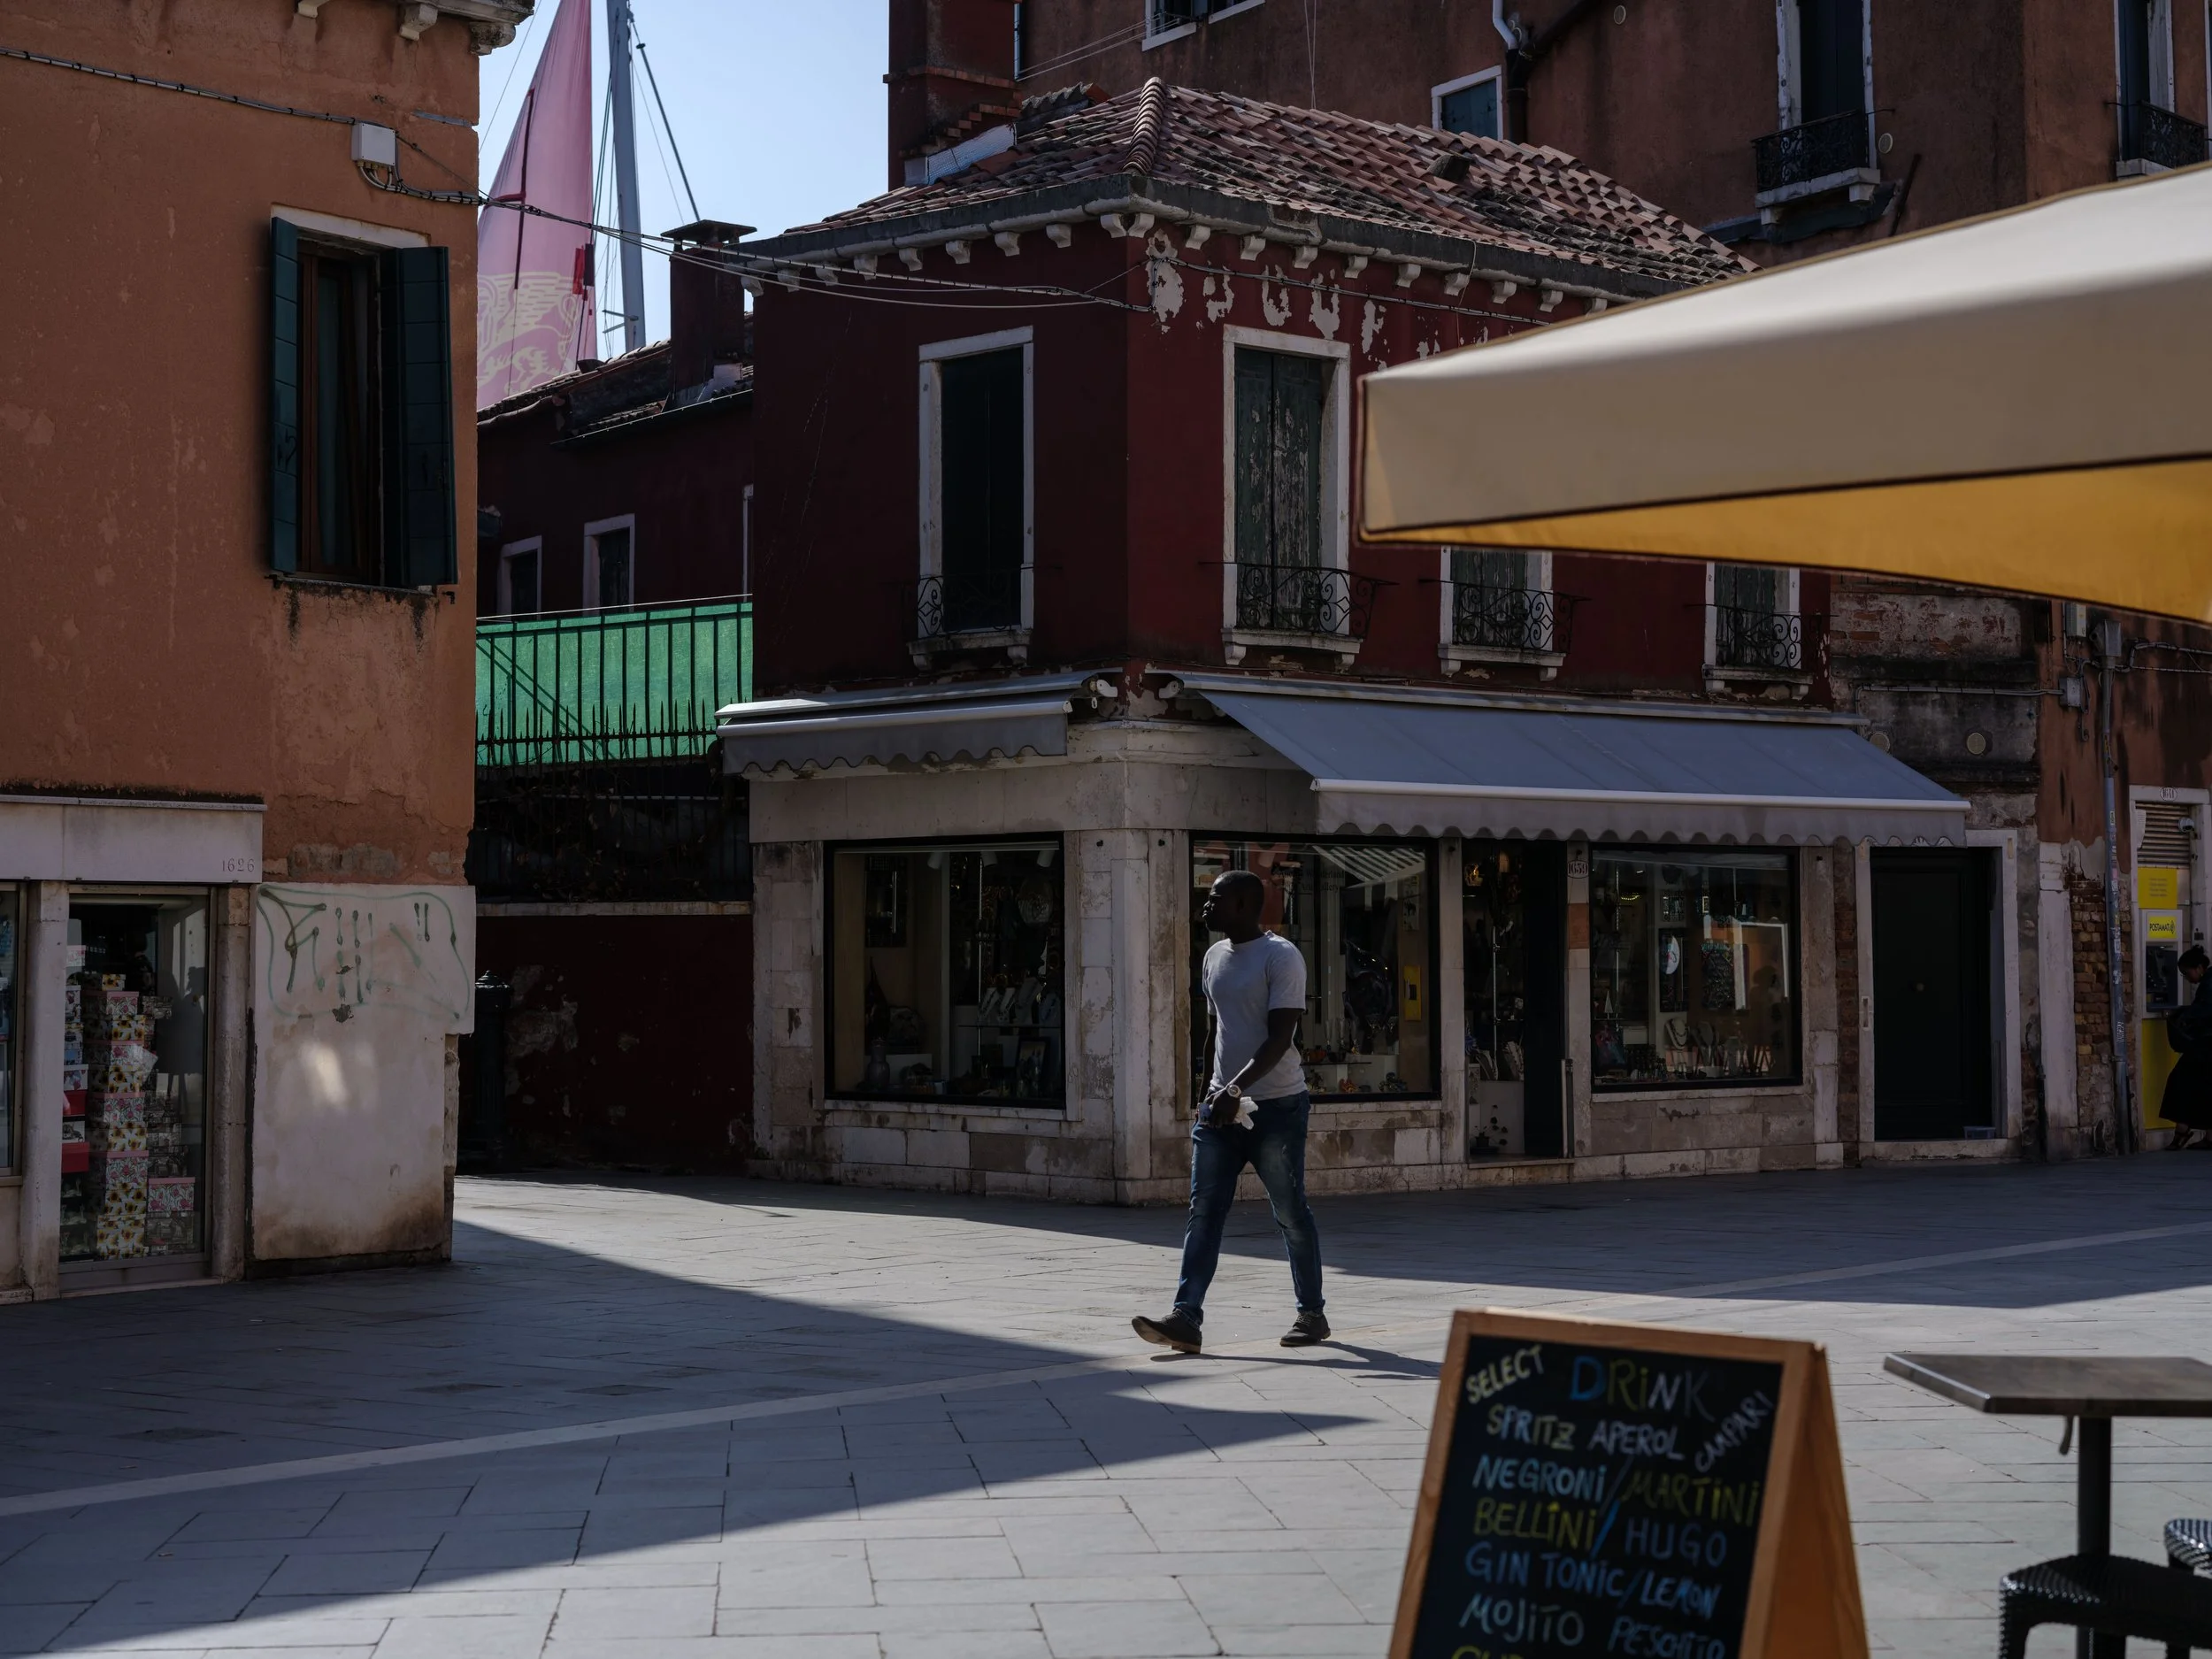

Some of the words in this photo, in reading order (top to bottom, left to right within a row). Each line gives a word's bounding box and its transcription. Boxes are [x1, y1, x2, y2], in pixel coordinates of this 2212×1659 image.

[222, 857, 255, 872] 1626
[1568, 863, 1588, 874] 1659
[2149, 923, 2170, 932] POSTAMAT
[1464, 1344, 1545, 1405] SELECT
[1486, 1402, 1577, 1451] SPRITZ
[1586, 1418, 1686, 1462] APEROL
[1464, 1540, 1532, 1588] GIN
[1624, 1517, 1727, 1569] HUGO
